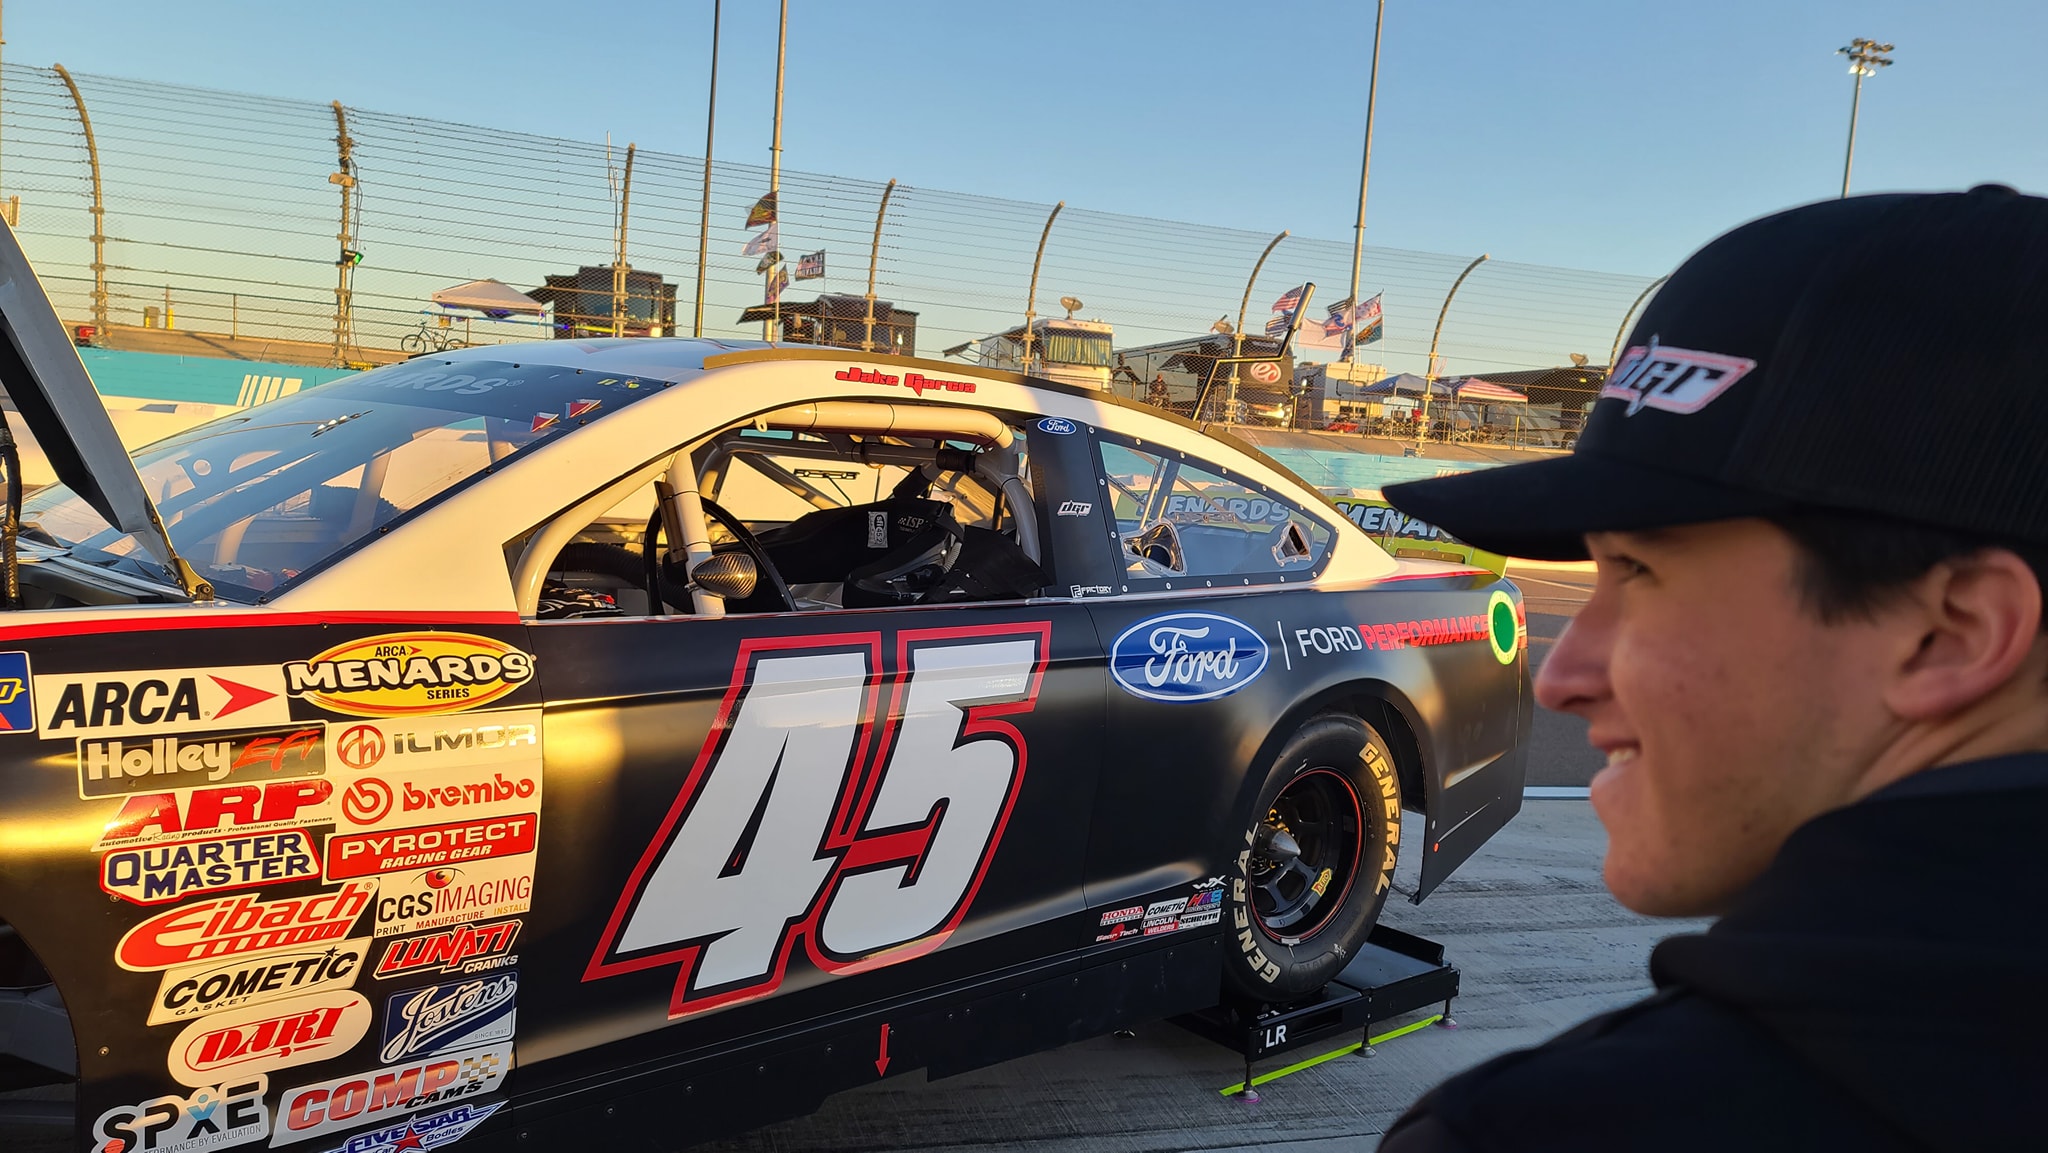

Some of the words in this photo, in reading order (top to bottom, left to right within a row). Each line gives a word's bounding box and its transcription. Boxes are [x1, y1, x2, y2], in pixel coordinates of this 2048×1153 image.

[835, 366, 900, 386] Jake
[904, 372, 977, 397] Garcia
[1046, 419, 1071, 433] Ford
[375, 645, 406, 657] ARCA
[1295, 625, 1363, 657] FORD
[1358, 614, 1489, 651] PERFORMANCE
[284, 654, 533, 694] MENARDS
[1145, 626, 1239, 687] Ford
[48, 678, 201, 730] ARCA
[427, 688, 470, 700] SERIES
[87, 738, 231, 781] Holley
[231, 728, 321, 773] EFI
[394, 724, 537, 754] ILMOR
[102, 779, 333, 840] ARP
[403, 773, 535, 811] brembo
[99, 836, 152, 847] automotive
[182, 828, 222, 838] products
[227, 823, 272, 832] Professional
[273, 819, 298, 828] Quality
[299, 816, 333, 825] Fasteners
[598, 631, 1044, 1005] 45
[1358, 742, 1401, 897] GENERAL
[108, 833, 302, 886] QUARTER
[342, 820, 527, 860] PYROTECT
[380, 850, 447, 869] RACING
[449, 844, 493, 860] GEAR
[144, 854, 311, 899] MASTER
[376, 924, 406, 936] PRINT
[416, 910, 485, 929] MANUFACTURE
[493, 903, 528, 915] INSTALL
[1103, 907, 1144, 920] HONDA
[1143, 916, 1174, 929] LINCOLN
[1147, 902, 1186, 916] COMETIC
[1233, 821, 1281, 984] GENERAL
[120, 883, 369, 967] Eibach
[380, 922, 516, 973] LUNATI
[464, 955, 518, 974] CRANKS
[164, 947, 359, 1009] COMETIC
[175, 995, 250, 1016] GASKET
[380, 975, 518, 1064] Jostens
[195, 1000, 359, 1067] DART
[1265, 1024, 1287, 1049] LR
[286, 1060, 461, 1131] COMP
[404, 1081, 484, 1110] CAMS
[198, 1136, 211, 1148] BY
[211, 1125, 262, 1144] EVALUATION
[349, 1128, 405, 1153] FIVE
[414, 1107, 471, 1133] STAR
[426, 1126, 464, 1143] Bodies
